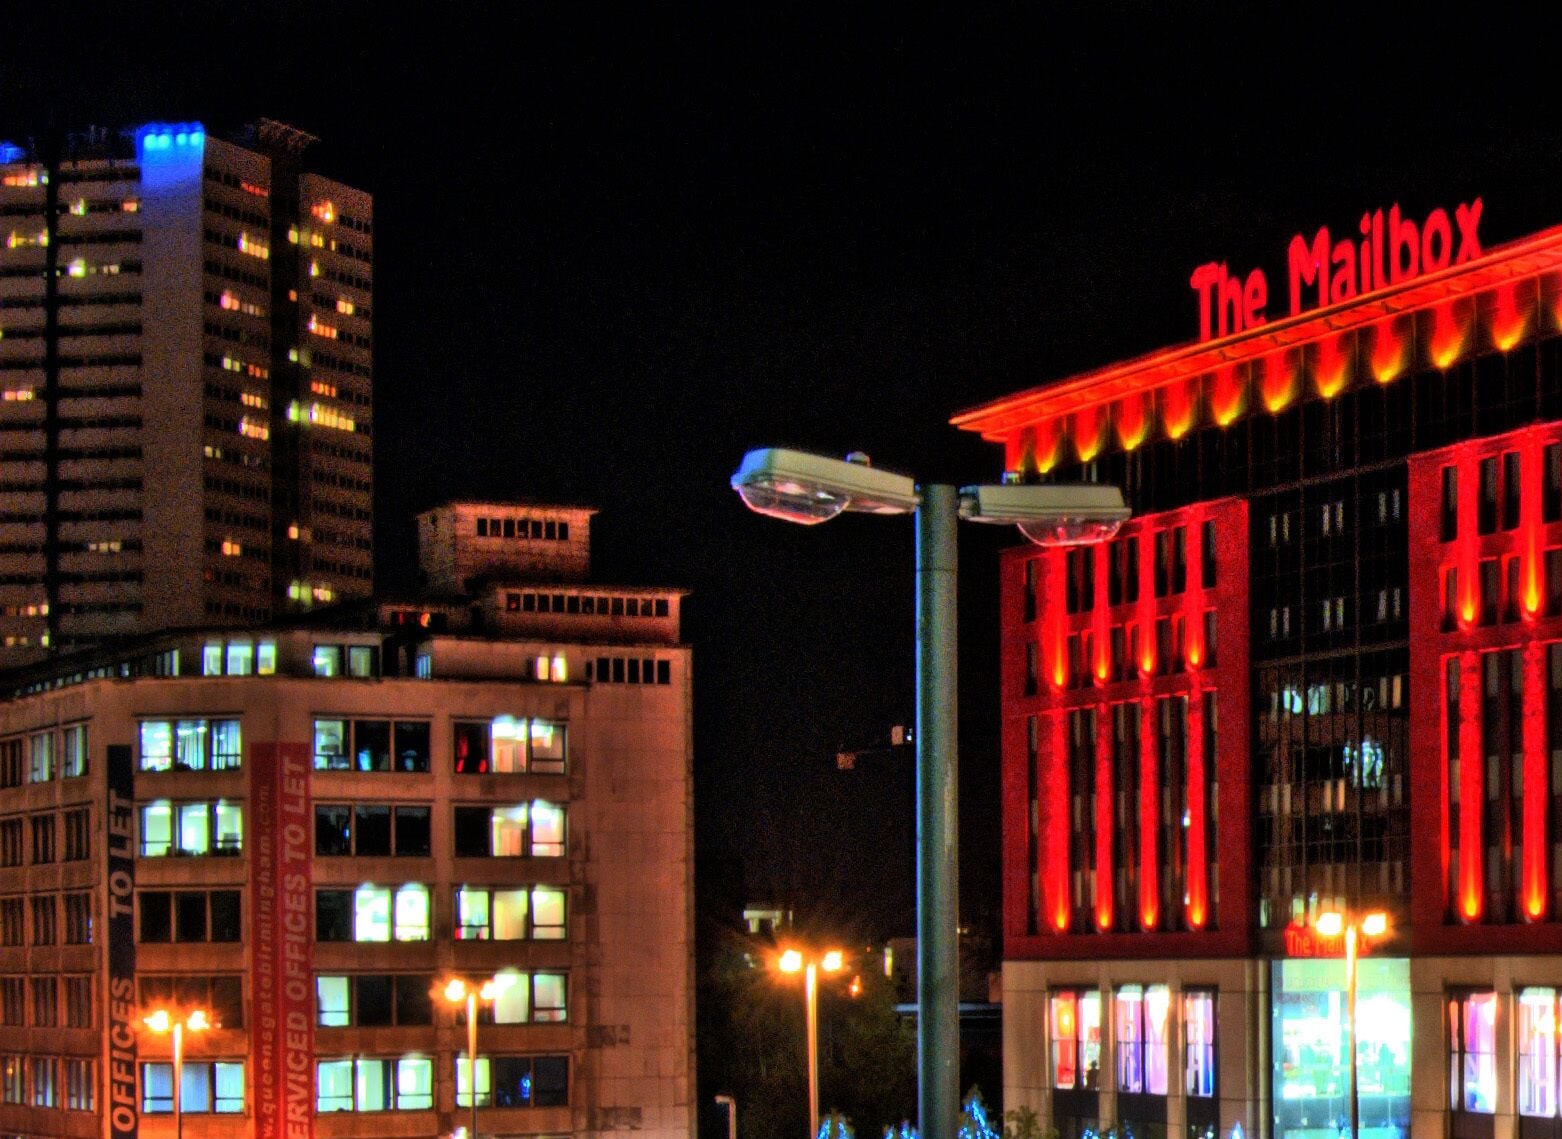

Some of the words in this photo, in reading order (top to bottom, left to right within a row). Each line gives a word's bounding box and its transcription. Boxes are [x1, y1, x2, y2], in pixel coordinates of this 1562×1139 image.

[1191, 260, 1268, 341] The
[1287, 197, 1484, 319] Mailbox
[282, 756, 306, 812] LET
[109, 788, 133, 862] LET
[283, 823, 306, 863] TO
[109, 870, 133, 919] TO
[284, 873, 309, 1000] OFFICES
[1287, 930, 1311, 954] The
[111, 976, 136, 1132] OFFICES
